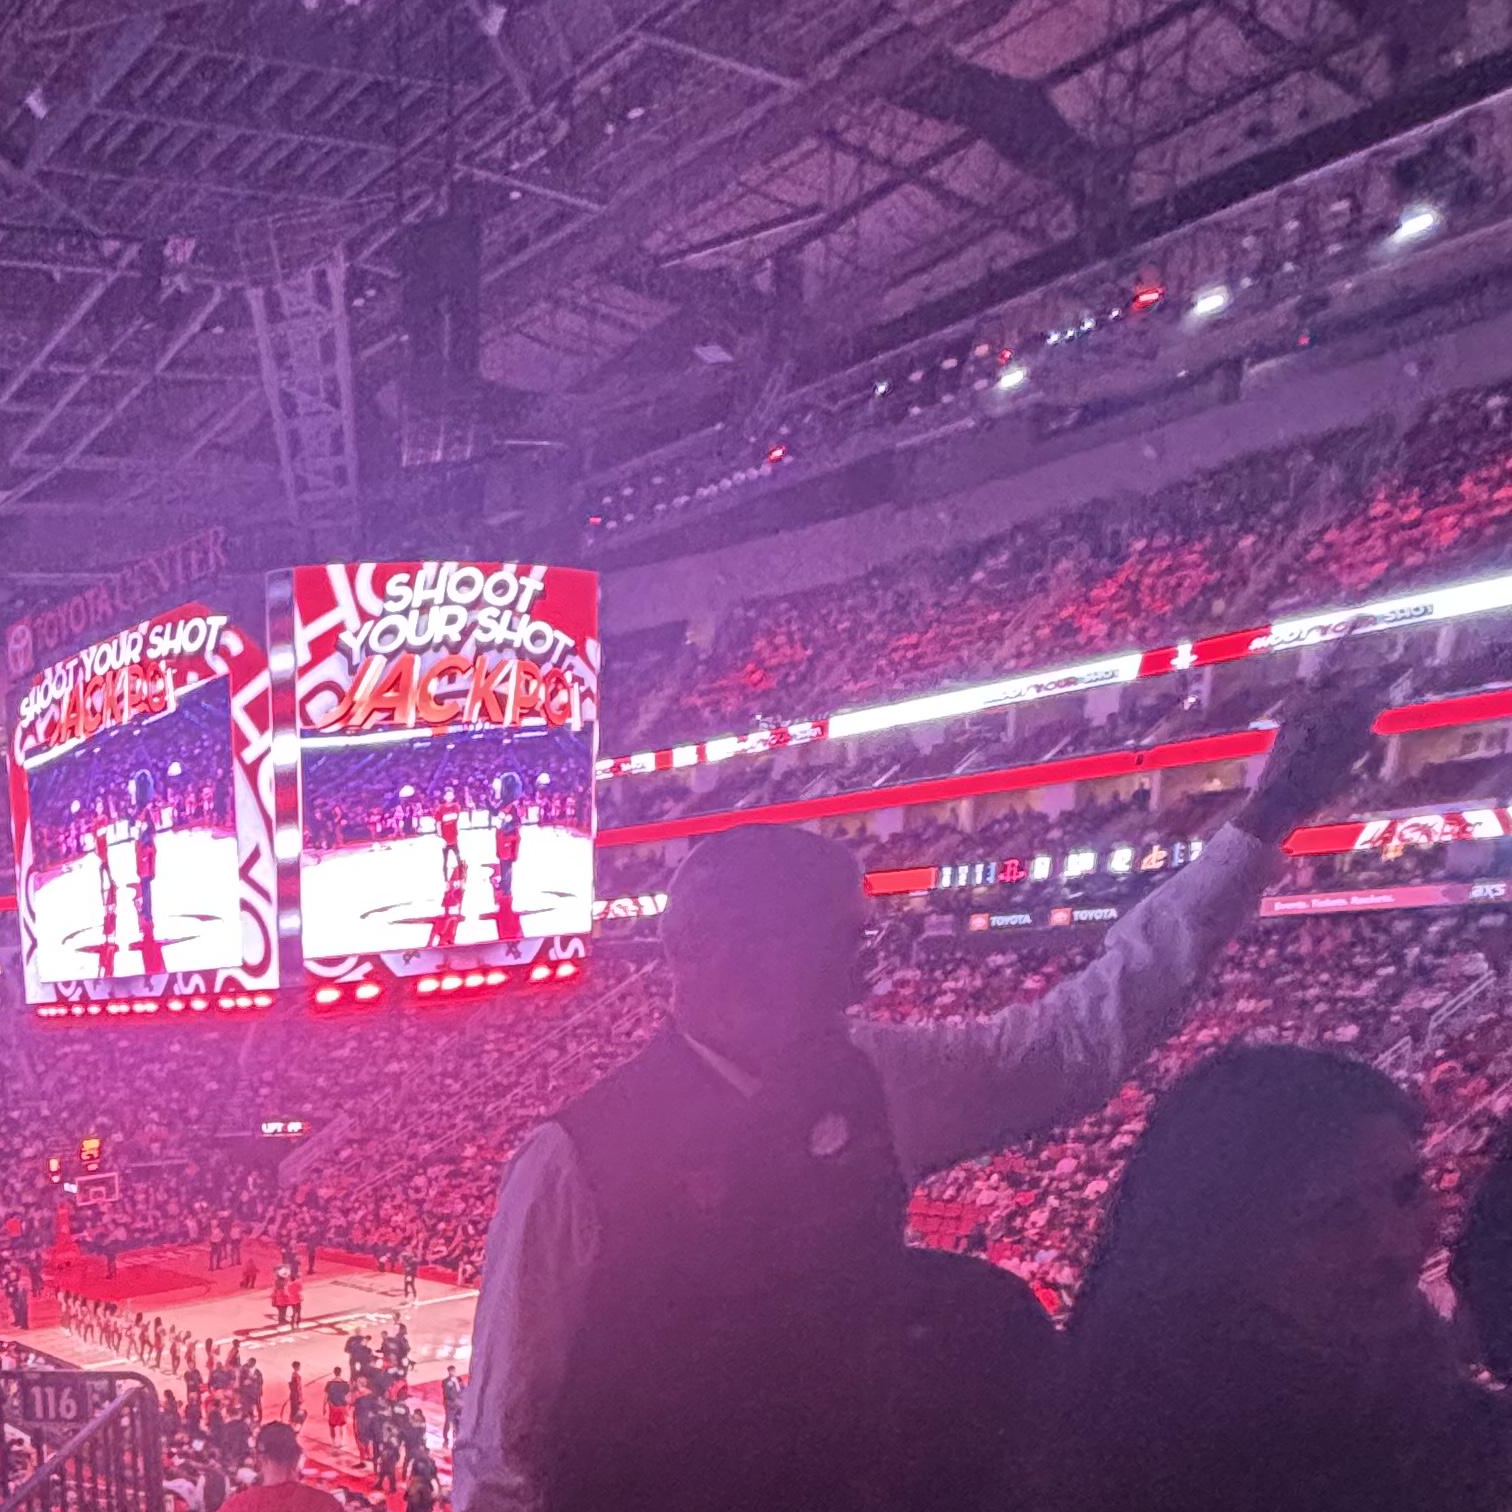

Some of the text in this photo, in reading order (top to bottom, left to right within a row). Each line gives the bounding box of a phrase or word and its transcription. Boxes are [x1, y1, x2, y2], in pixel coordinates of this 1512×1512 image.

[384, 566, 544, 613] SHOOT
[339, 605, 575, 665] YOUR SHOT
[19, 615, 228, 728] SHOOT YOUR SHOT
[990, 914, 1032, 927] TOYOTA
[1072, 908, 1118, 921] TOYOTA
[30, 1386, 77, 1419] 116
